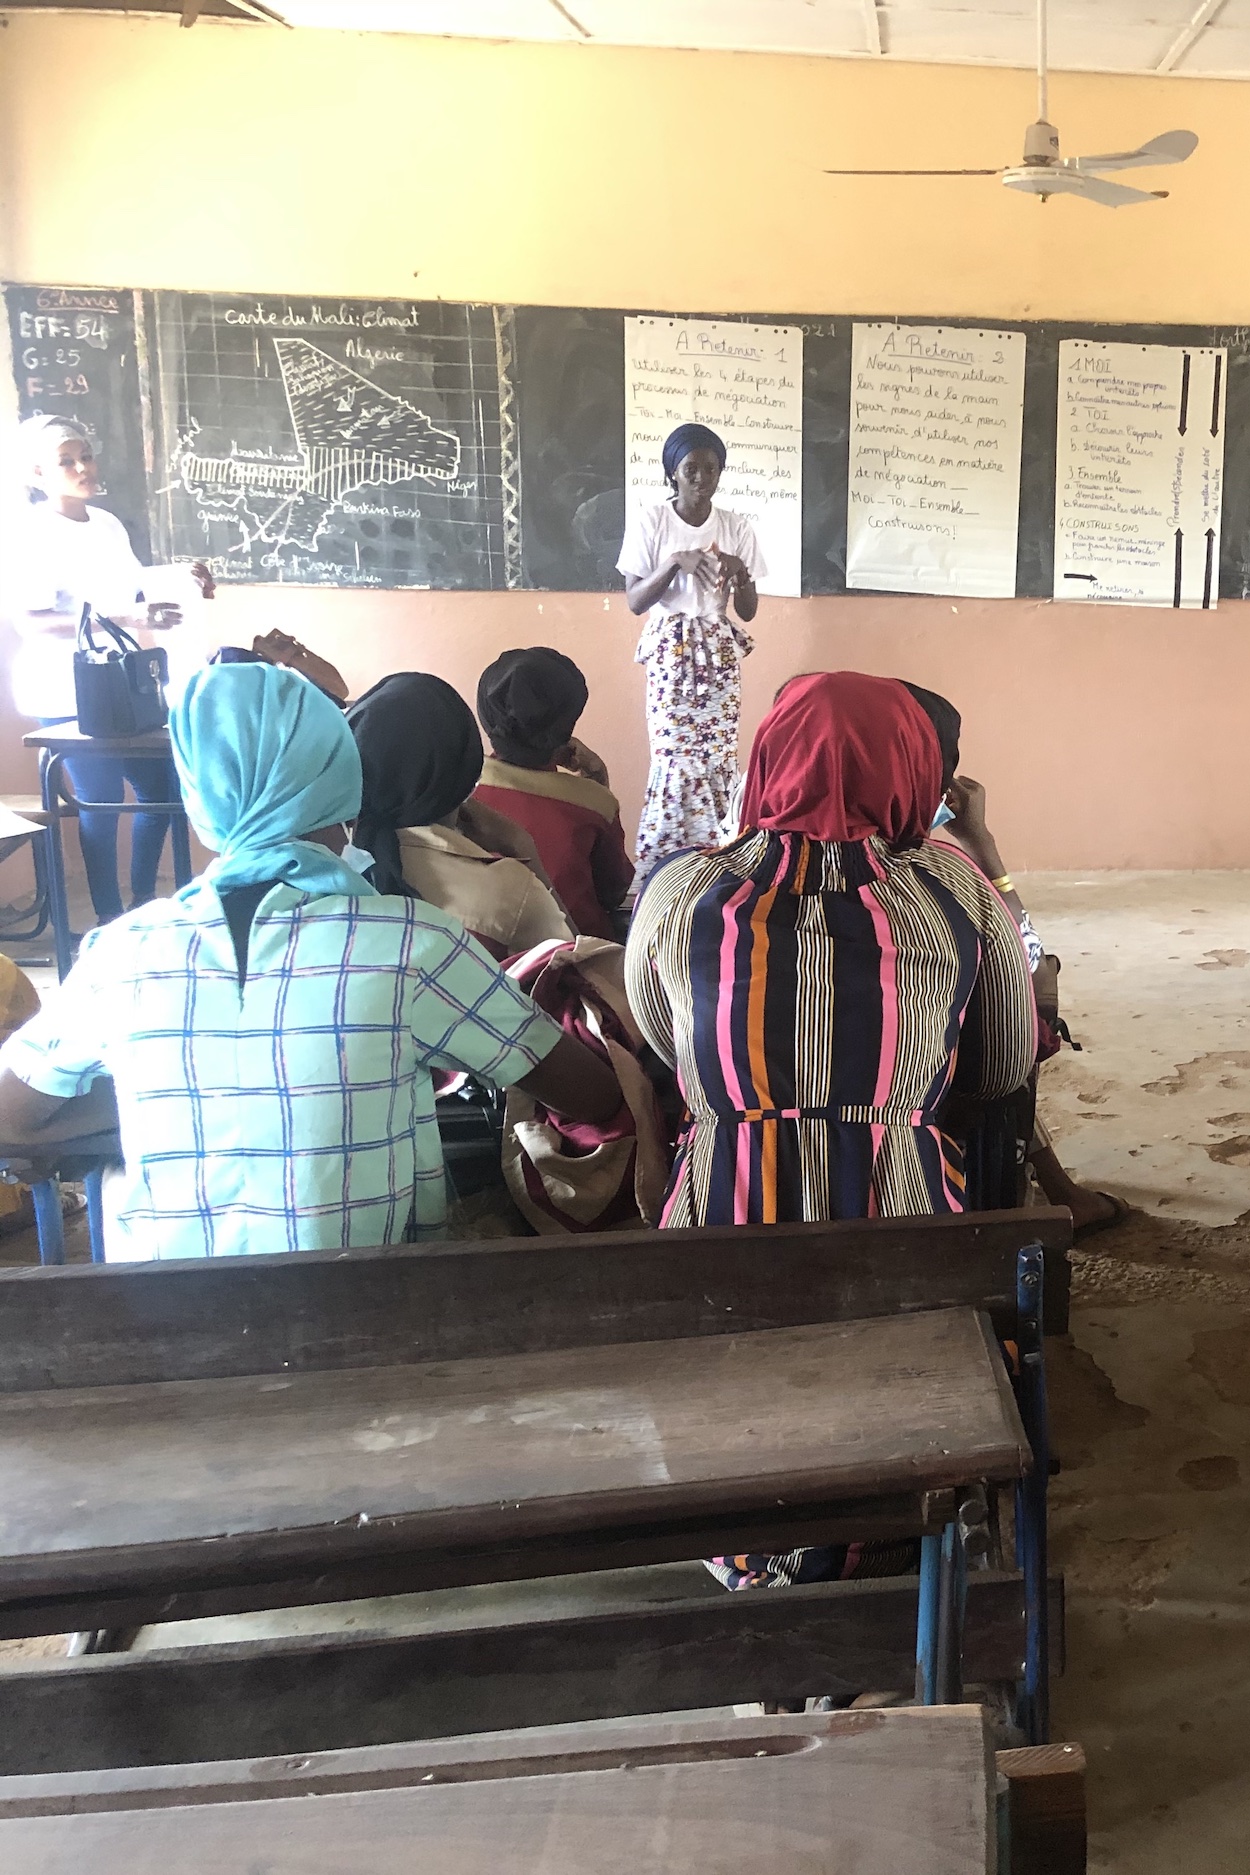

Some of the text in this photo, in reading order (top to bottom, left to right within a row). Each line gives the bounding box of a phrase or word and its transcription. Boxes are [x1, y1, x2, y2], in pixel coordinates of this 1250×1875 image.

[676, 330, 688, 350] A
[882, 332, 895, 352] A
[866, 355, 901, 373] Nous
[924, 385, 939, 399] de
[855, 400, 887, 419] pour
[722, 461, 767, 477] onclure
[854, 467, 870, 479] de
